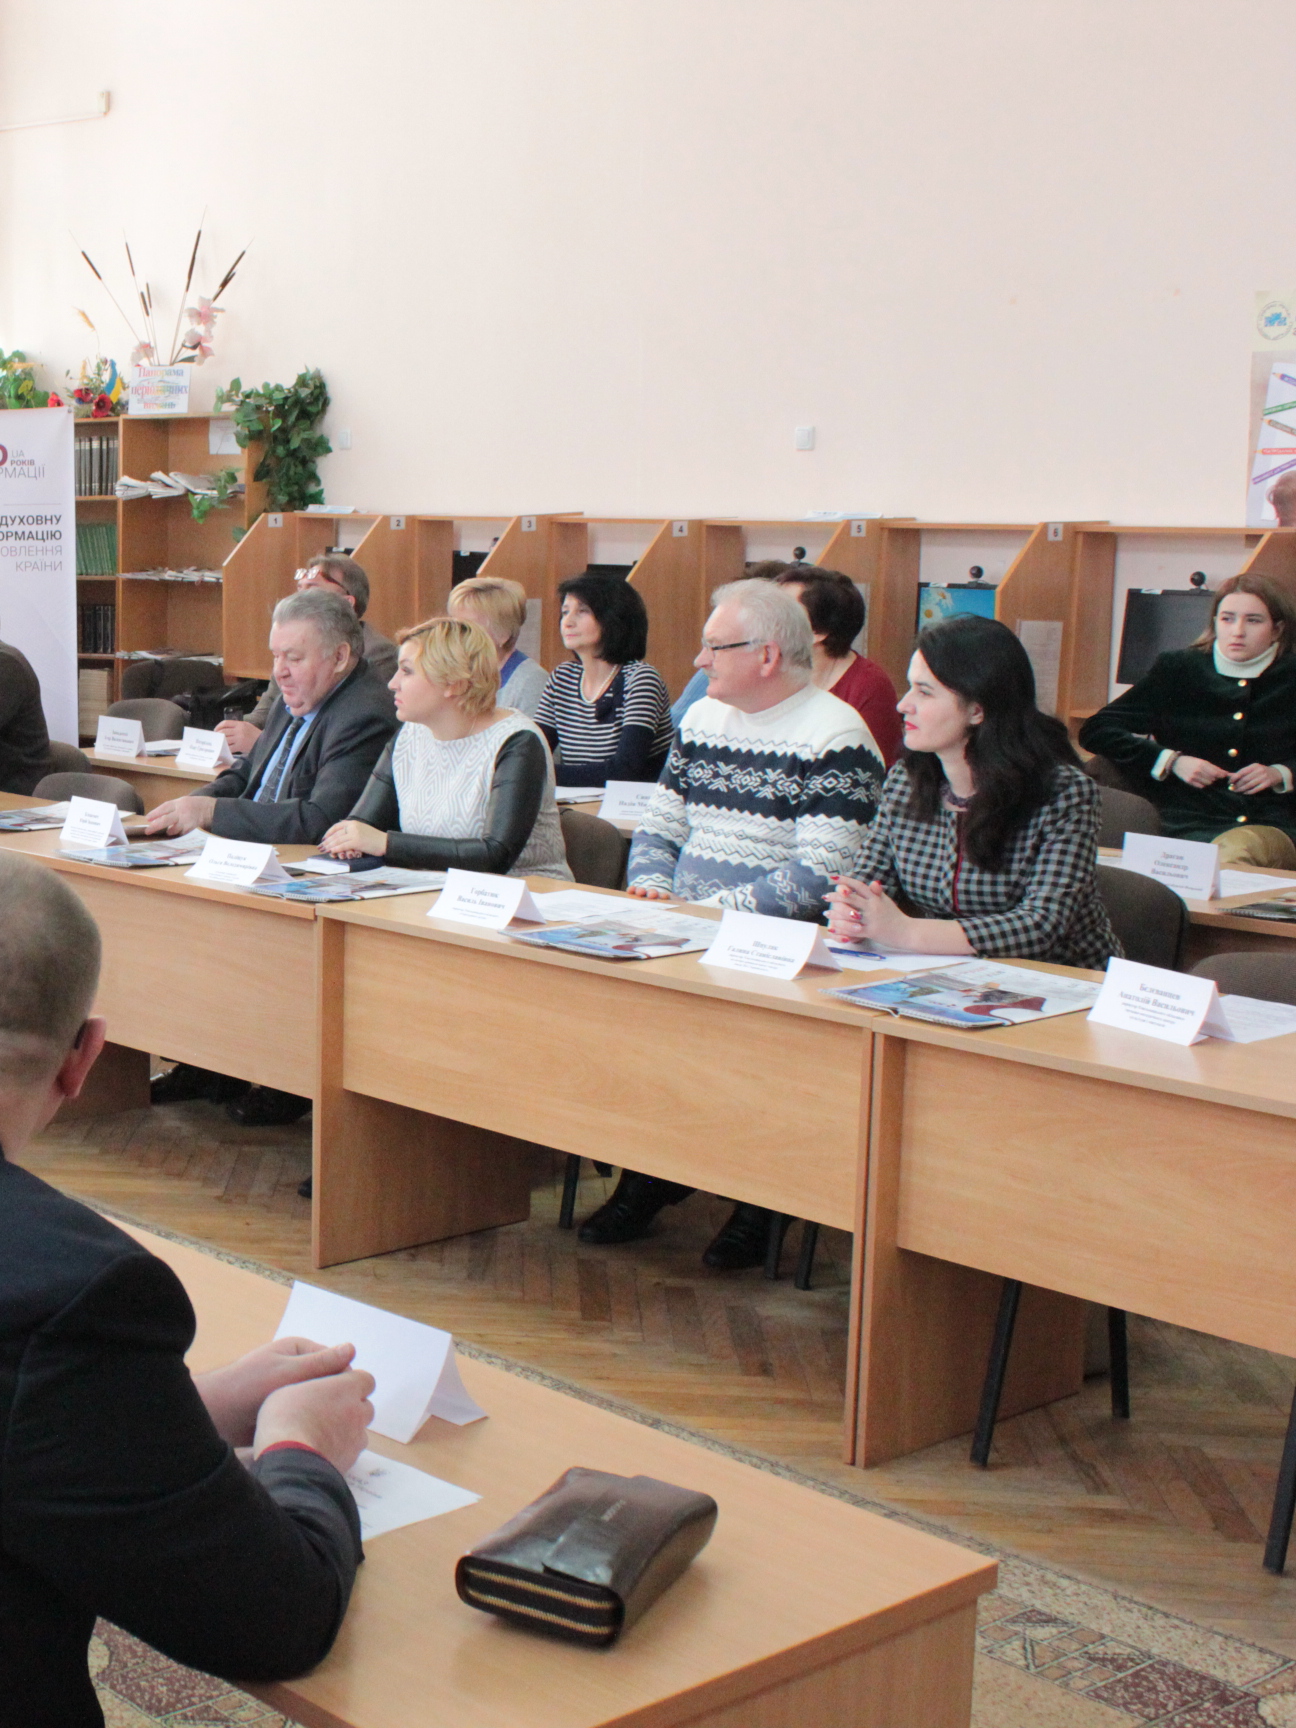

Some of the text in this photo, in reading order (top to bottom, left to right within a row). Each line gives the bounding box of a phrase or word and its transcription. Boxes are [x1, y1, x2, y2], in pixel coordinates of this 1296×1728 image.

[138, 367, 184, 379] Панорама
[526, 520, 532, 529] 3
[856, 524, 862, 533] 5
[678, 525, 684, 534] 4
[1053, 528, 1059, 537] 6
[15, 559, 63, 572] КРАЇНИ
